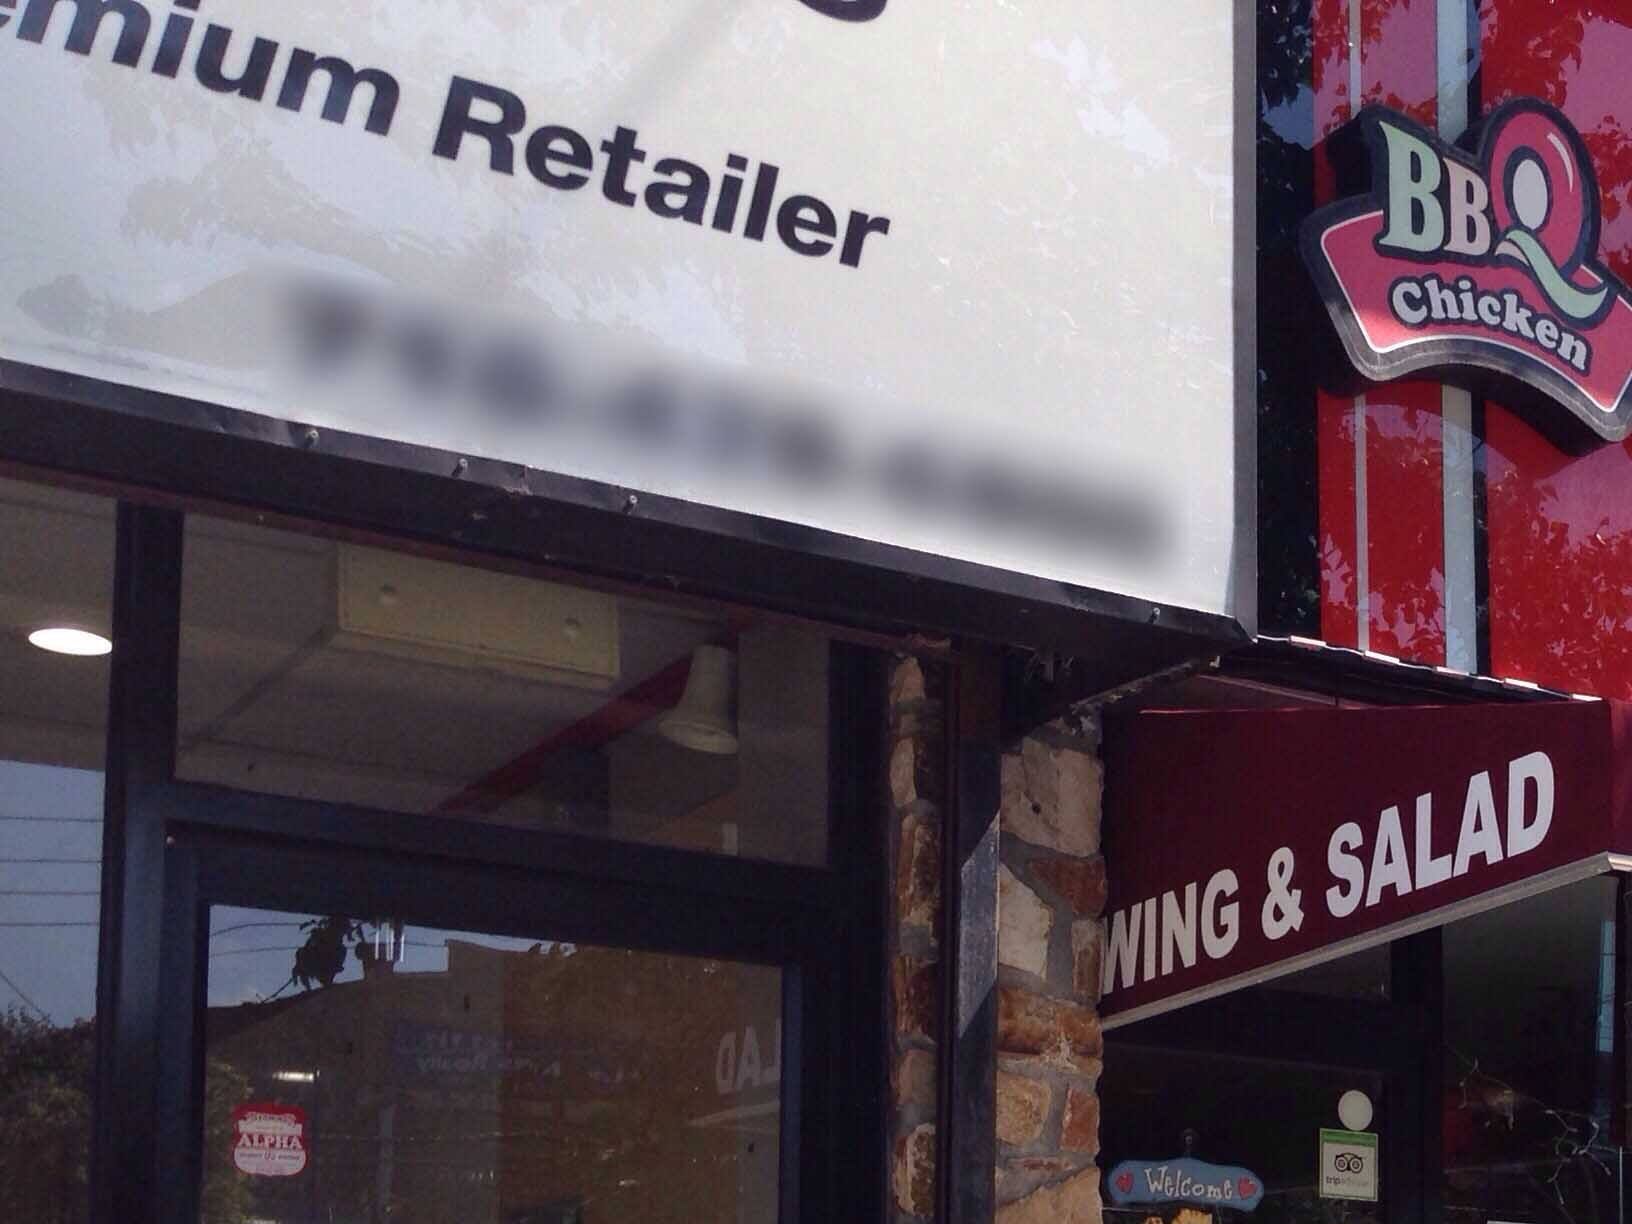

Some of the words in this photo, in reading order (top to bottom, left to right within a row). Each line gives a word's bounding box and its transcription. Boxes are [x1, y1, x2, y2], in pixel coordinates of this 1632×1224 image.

[0, 0, 401, 137] mium
[430, 74, 891, 270] Retailer
[1378, 110, 1609, 319] BBQ
[1391, 279, 1590, 371] Chicken
[1102, 868, 1239, 995] WING
[1261, 846, 1304, 940] &
[1325, 751, 1555, 918] SALAD
[1144, 1165, 1233, 1201] Welcome
